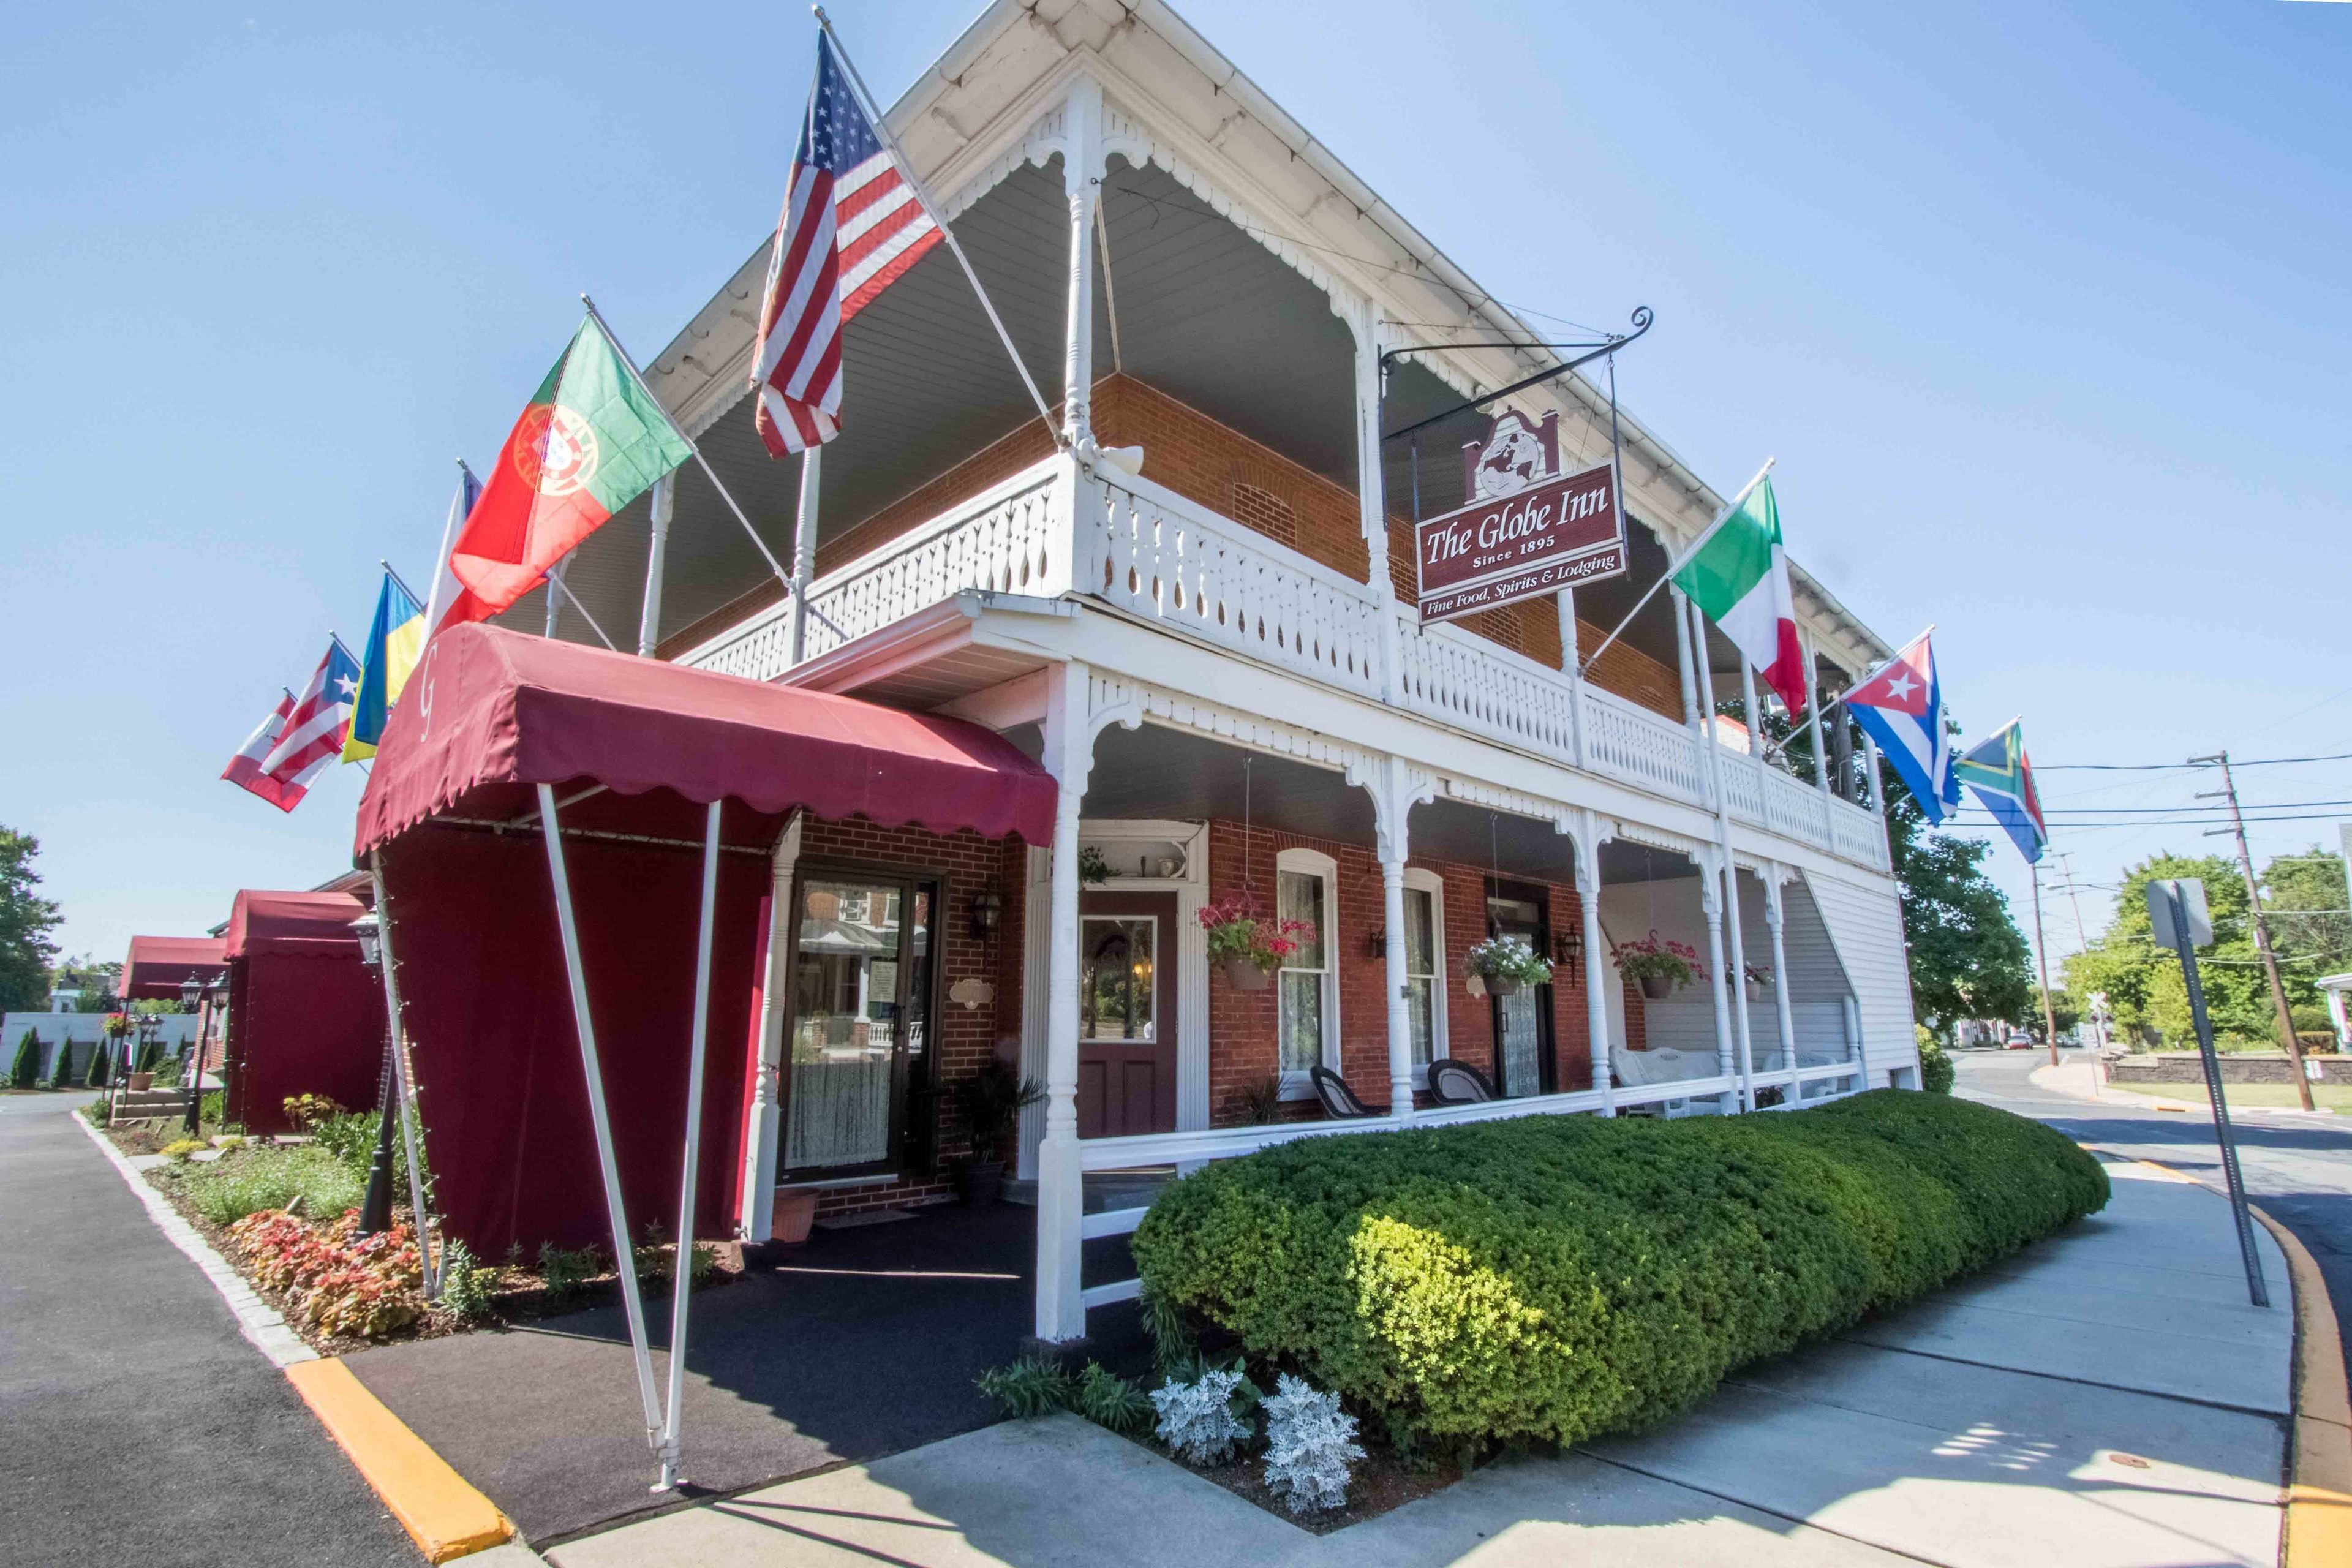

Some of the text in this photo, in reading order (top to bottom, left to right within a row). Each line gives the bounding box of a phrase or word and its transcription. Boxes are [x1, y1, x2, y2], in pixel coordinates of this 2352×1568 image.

[1427, 486, 1608, 564] The Globe Inn
[1472, 535, 1555, 568] Since 1895
[1426, 555, 1616, 615] Fine Food, Spirits & Lodging
